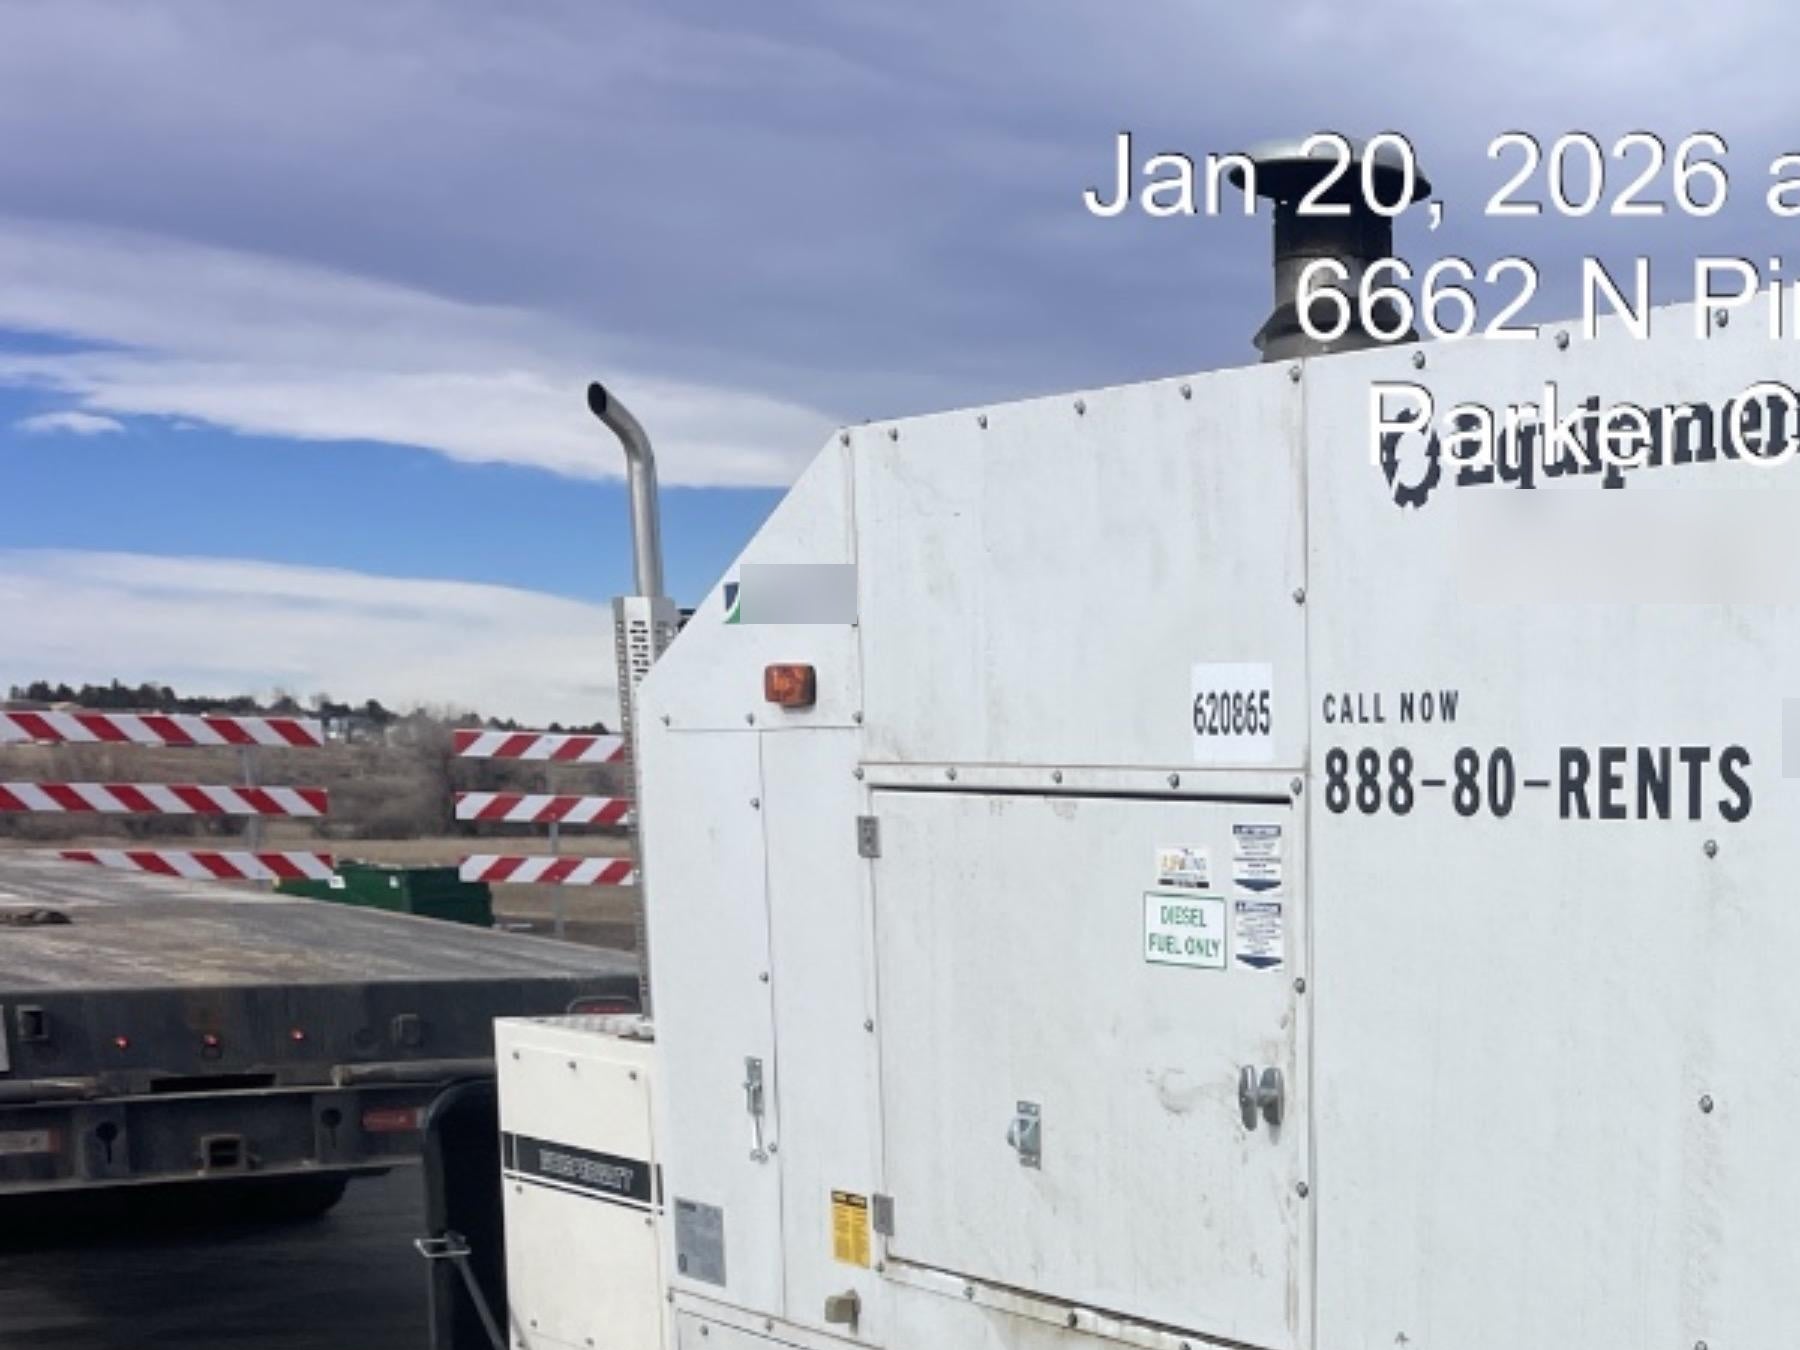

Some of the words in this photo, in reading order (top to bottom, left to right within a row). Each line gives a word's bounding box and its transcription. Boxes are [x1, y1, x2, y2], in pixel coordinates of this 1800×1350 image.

[1193, 689, 1271, 736] 620865
[1322, 692, 1386, 725] CALL
[1399, 690, 1460, 724] NOW
[1324, 745, 1753, 823] 888-80-RENTS
[1160, 905, 1208, 928] DIESEL
[1149, 932, 1183, 955] FUEL
[1184, 935, 1221, 958] ONLY
